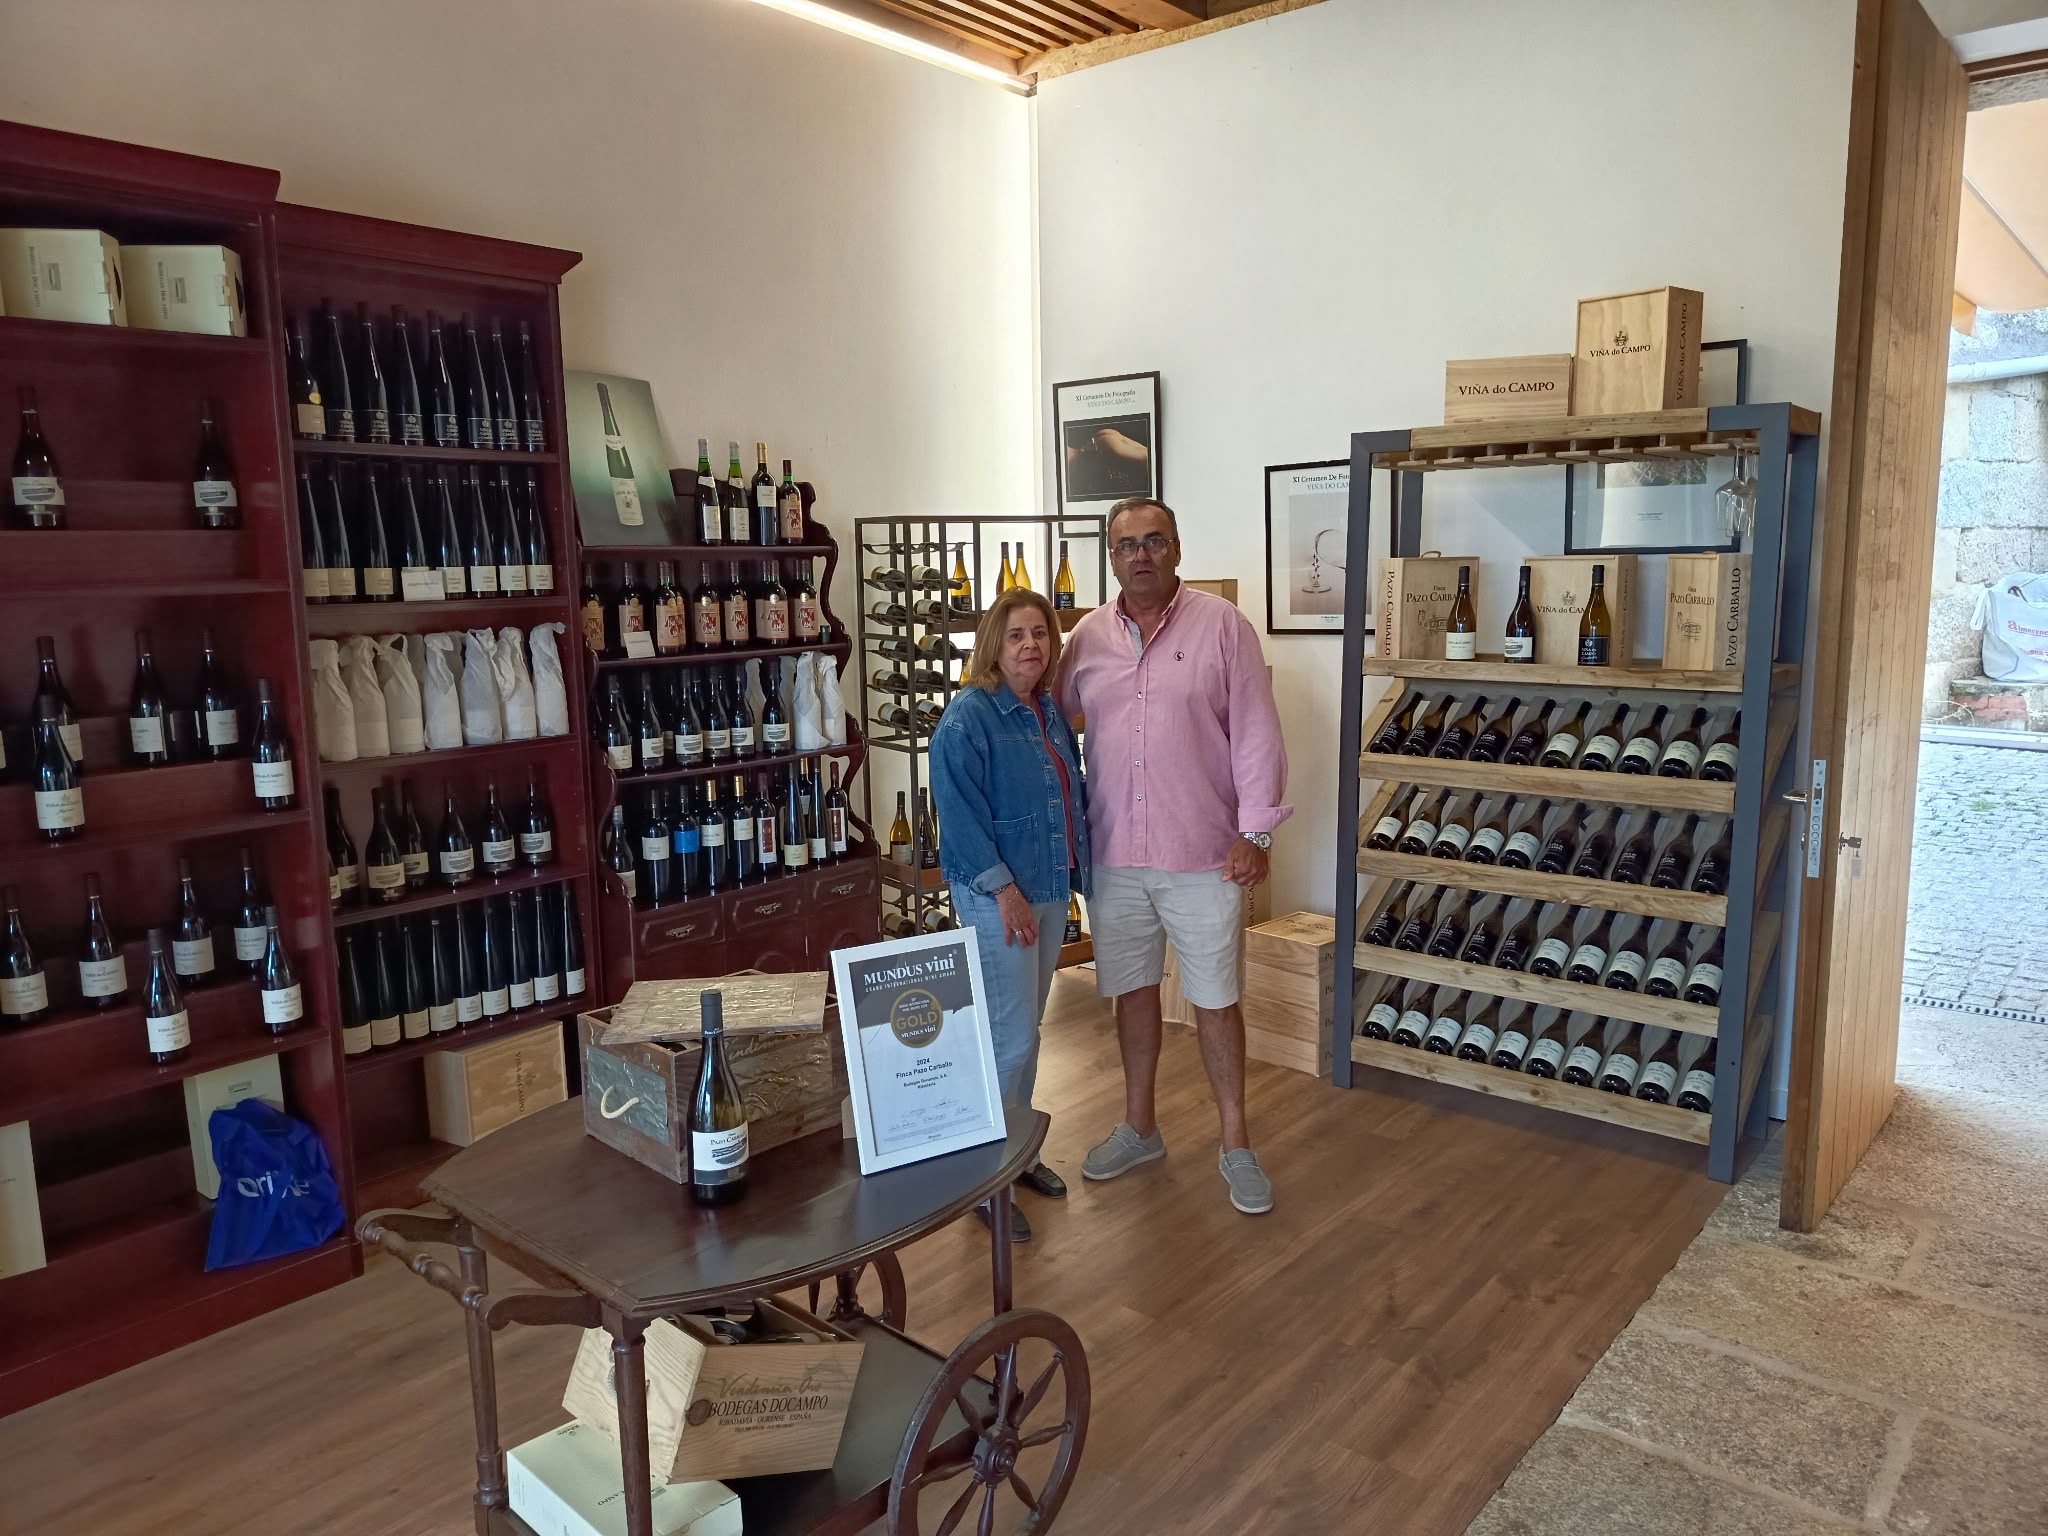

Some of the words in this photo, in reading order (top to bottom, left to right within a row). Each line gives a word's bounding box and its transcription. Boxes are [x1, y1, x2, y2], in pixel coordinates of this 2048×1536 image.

[1679, 303, 1688, 352] CAMPO
[1590, 347, 1610, 358] VIÑA
[1611, 348, 1620, 356] do
[1621, 344, 1651, 355] CAMPO
[1679, 353, 1686, 367] do
[1458, 383, 1489, 396] VIÑA
[1492, 384, 1506, 394] do
[1508, 381, 1555, 394] CAMPO
[1676, 370, 1686, 400] VIÑA
[1104, 391, 1112, 399] De
[1292, 476, 1300, 484] XI
[1300, 474, 1328, 483] Certamen
[1328, 474, 1337, 482] De
[1307, 483, 1325, 491] VIÑA
[1325, 482, 1336, 490] DO
[1385, 571, 1395, 598] PAZO
[1406, 592, 1428, 603] PAZO
[1429, 591, 1457, 602] CARBA
[1670, 592, 1685, 604] PAZO
[1685, 593, 1715, 606] CARBALLO
[1727, 567, 1742, 632] CARBALLO
[1536, 605, 1557, 614] VIÑA
[1558, 606, 1567, 614] do
[1385, 601, 1394, 656] CARBALLO
[1725, 635, 1738, 667] PAZO
[864, 963, 923, 985] MUNDUS
[925, 953, 955, 973] vini
[865, 984, 882, 993] GRAND
[885, 977, 923, 989] INTERNATIONAL
[939, 970, 956, 978] AWARD
[896, 1011, 938, 1030] GOLD
[901, 1029, 924, 1038] MUNDUS
[924, 1024, 936, 1033] vini
[896, 1071, 912, 1079] Finca
[913, 1067, 928, 1075] Pazo
[928, 1061, 953, 1071] Carballo
[916, 1057, 930, 1066] 2024
[517, 1083, 526, 1113] CAMPO
[719, 1372, 793, 1398] Vendimia
[799, 1375, 822, 1395] Oro
[707, 1398, 768, 1418] BODEGAS
[769, 1395, 829, 1413] DOCAMPO
[719, 1417, 753, 1426] RIBADAVIA
[757, 1414, 785, 1423] OURENSE
[789, 1411, 812, 1420] ESPAÑA
